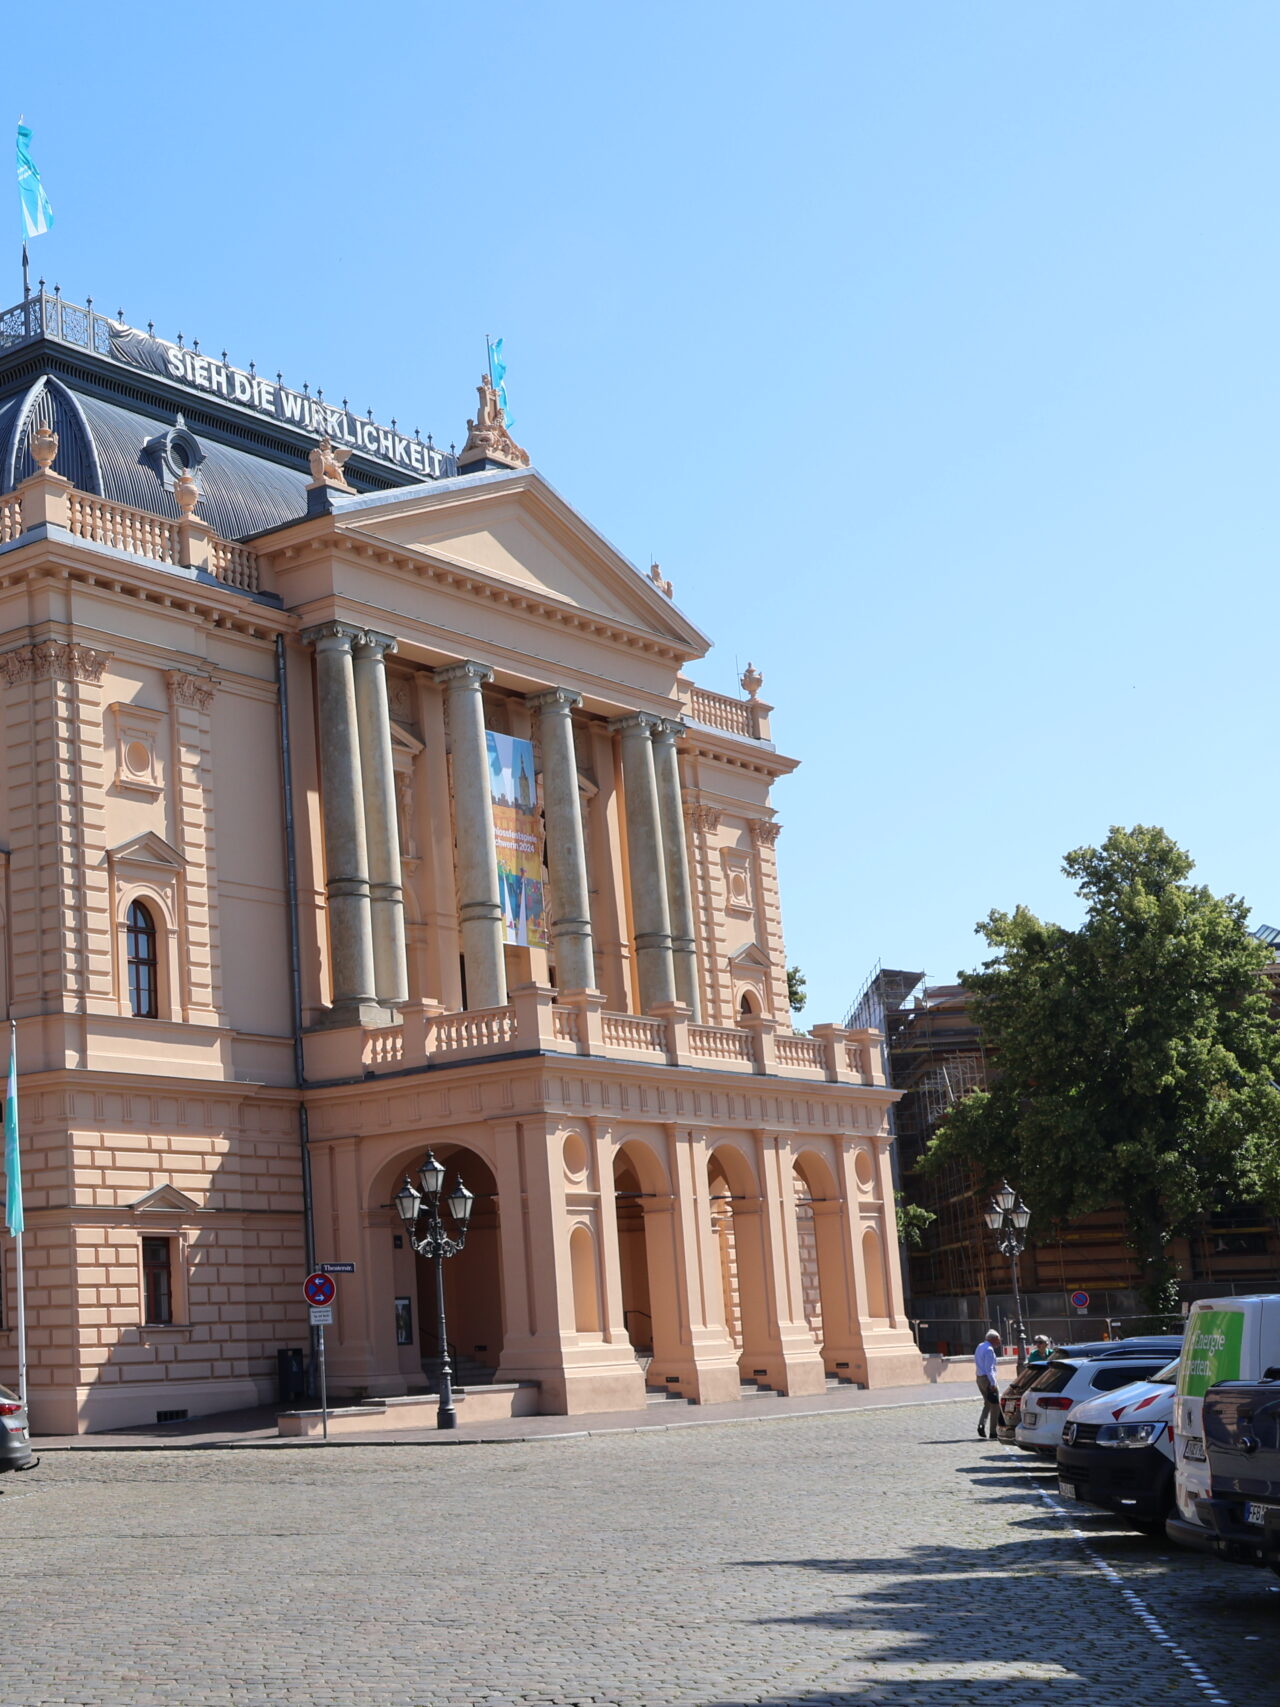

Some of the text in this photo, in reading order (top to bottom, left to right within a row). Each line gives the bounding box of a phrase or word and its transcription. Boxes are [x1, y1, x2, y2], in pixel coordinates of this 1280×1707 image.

[168, 348, 442, 477] SIEH DIE WIRKLICHKEIT
[495, 838, 517, 849] chwerin
[1194, 1329, 1225, 1356] Energie
[1249, 1503, 1261, 1521] FFB
